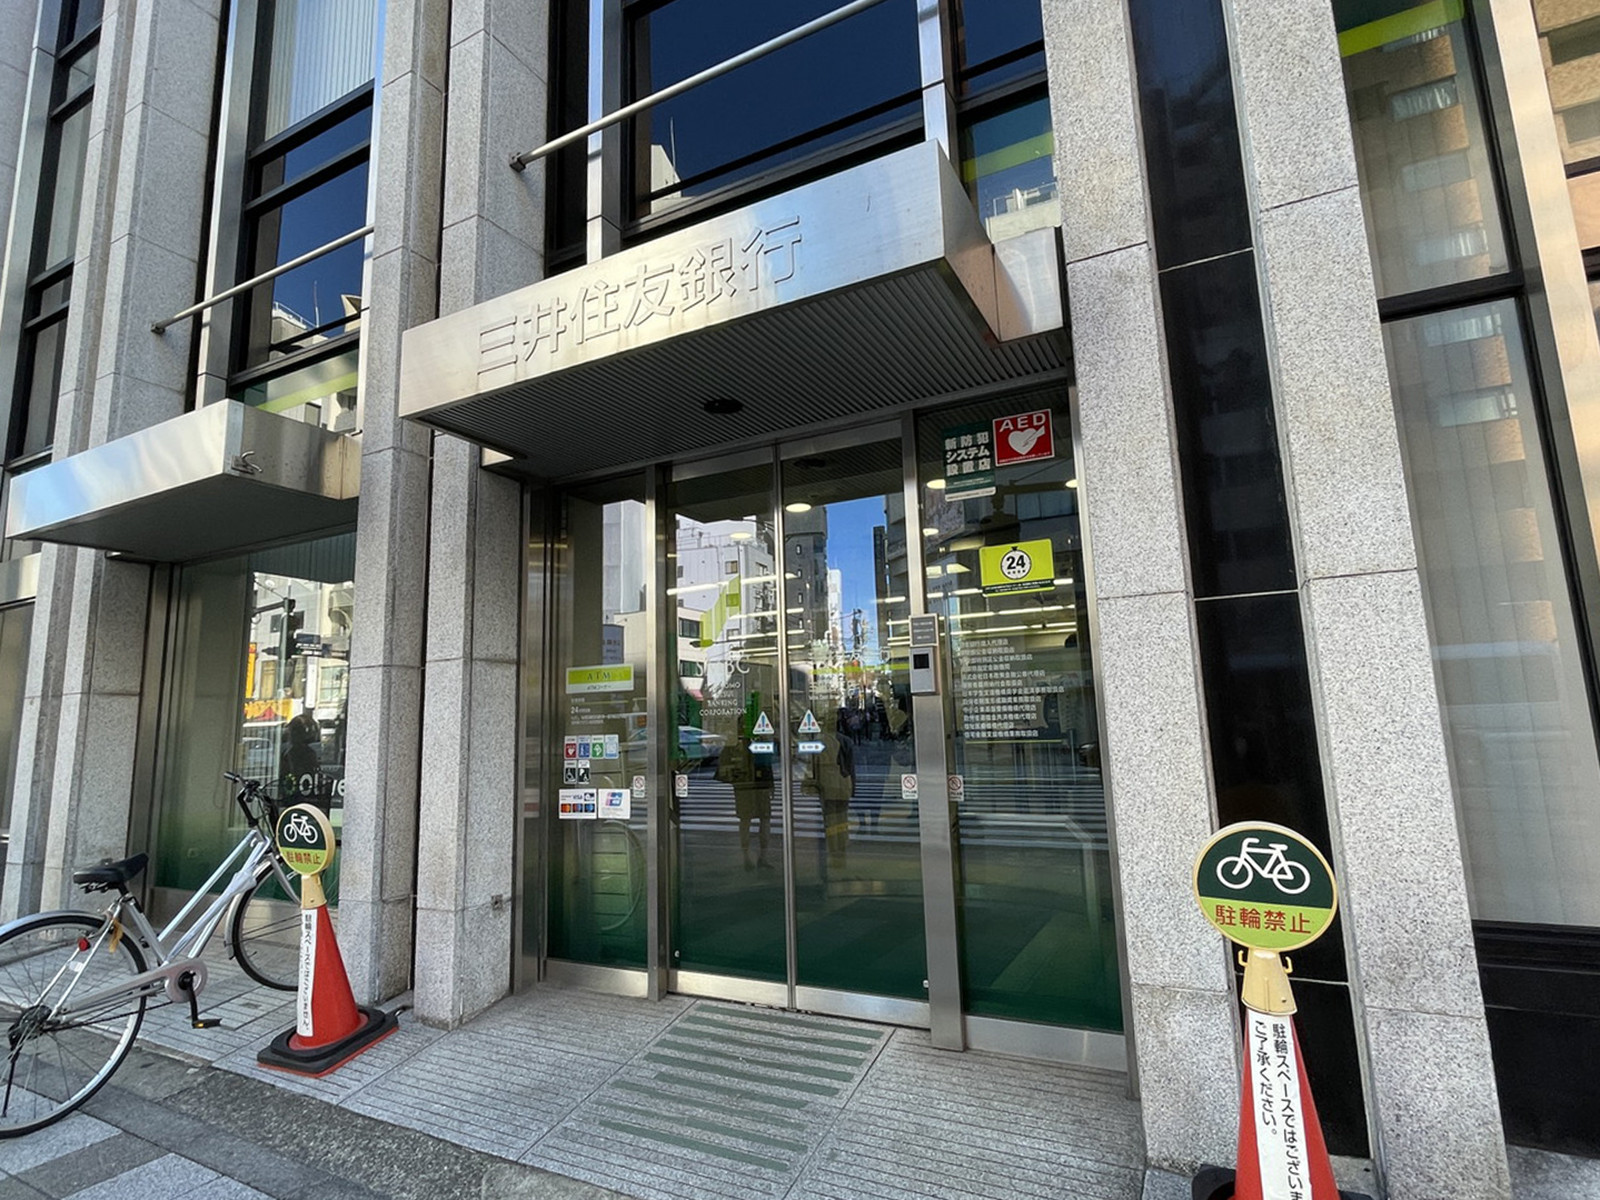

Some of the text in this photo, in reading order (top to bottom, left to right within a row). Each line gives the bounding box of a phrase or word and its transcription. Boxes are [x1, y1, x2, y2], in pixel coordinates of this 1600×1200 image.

[477, 215, 803, 377] 三井住友銀行
[999, 413, 1046, 433] AED
[945, 445, 990, 463] システム
[946, 458, 991, 476] 設置店
[1006, 554, 1026, 570] 24
[286, 851, 321, 865] 駐輪禁止
[1215, 904, 1312, 934] 駐輪禁止
[1255, 1020, 1278, 1136] ご了承ください。
